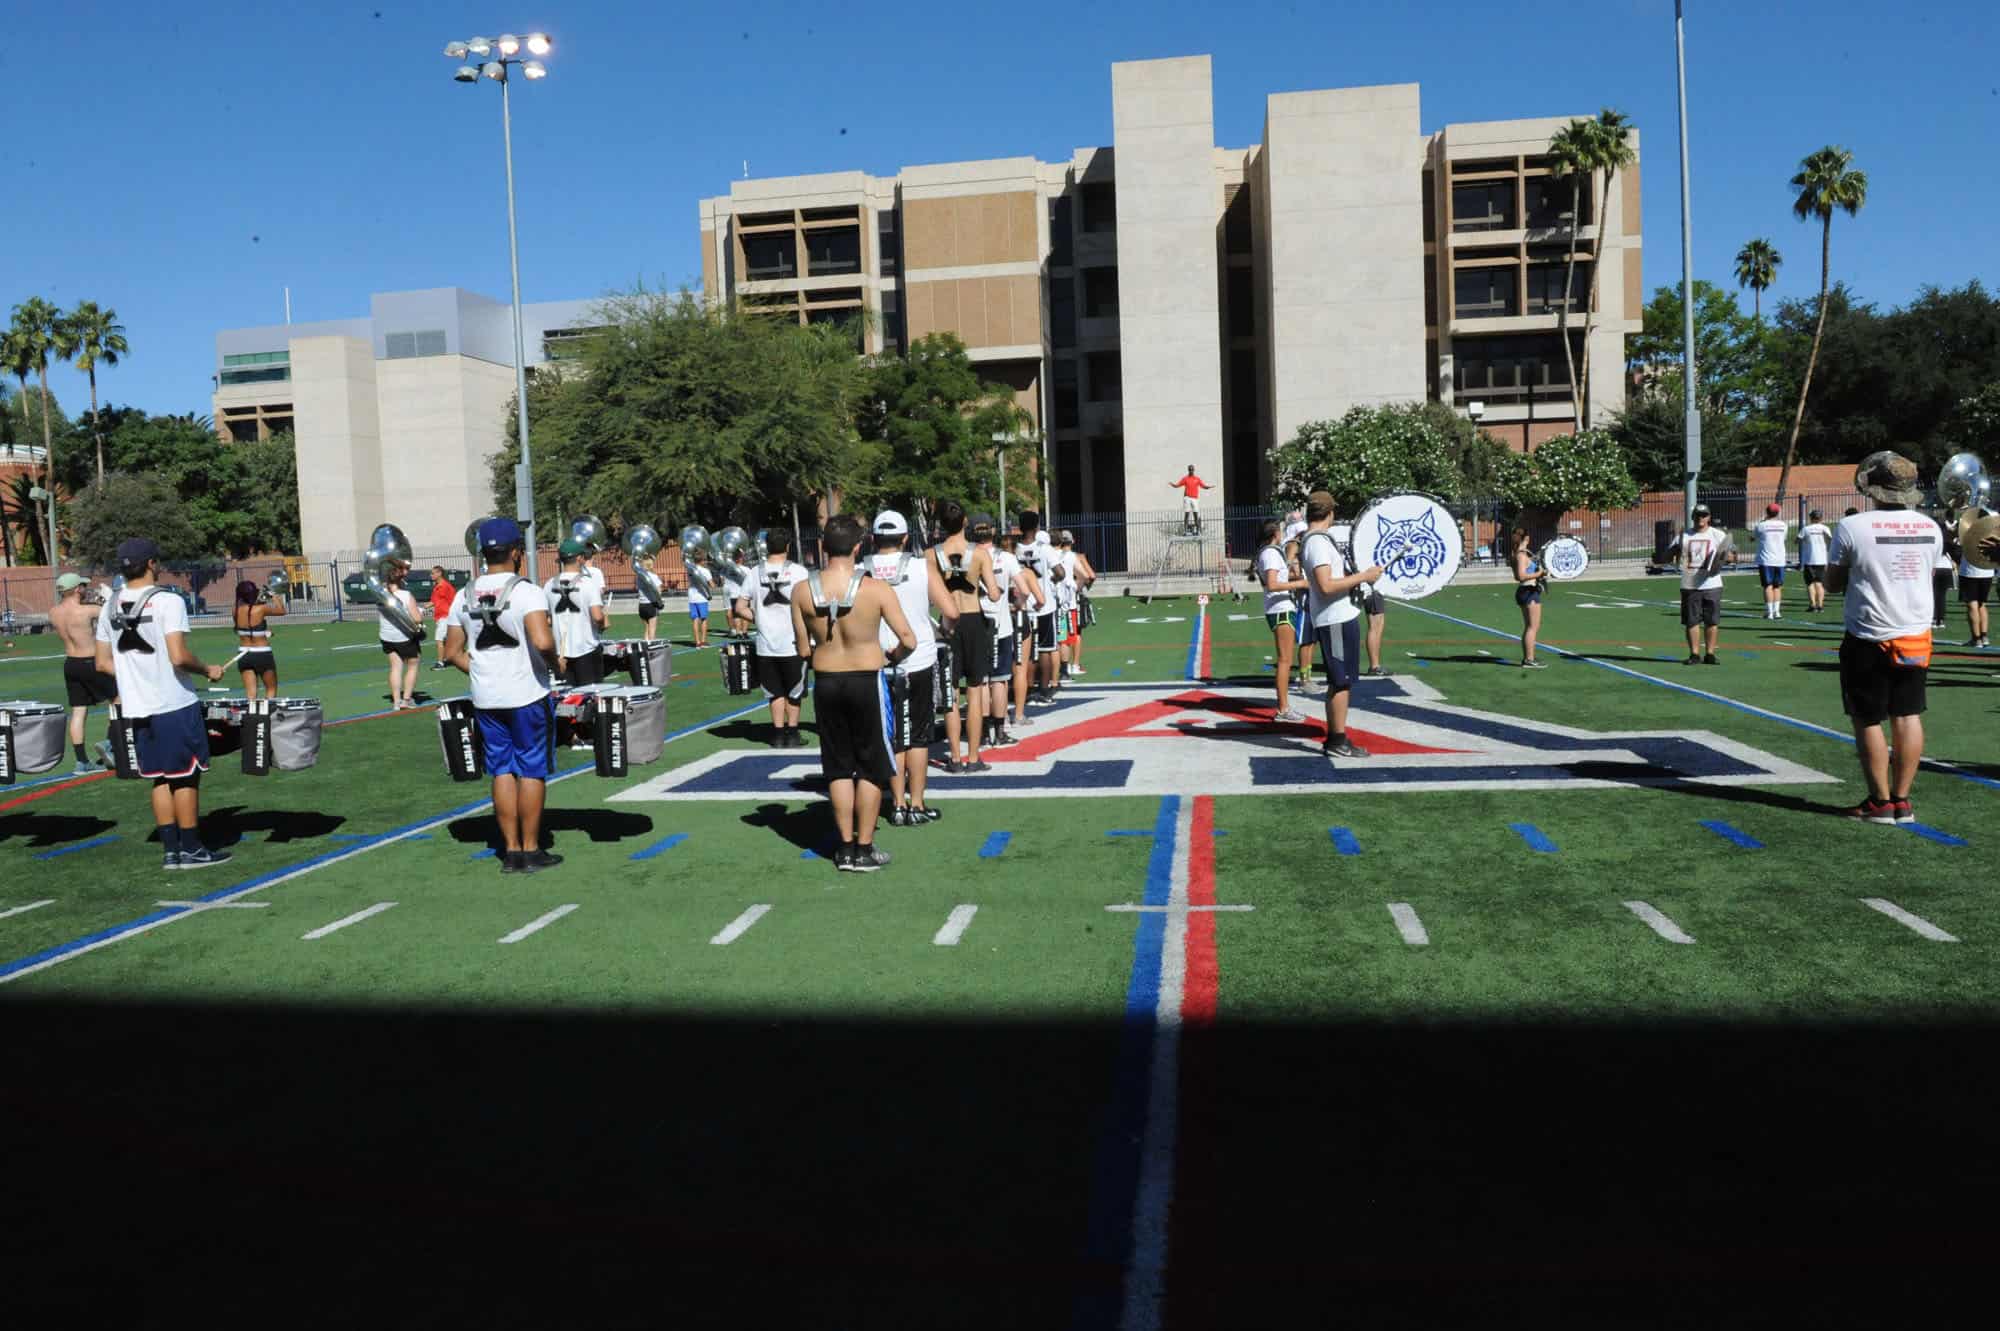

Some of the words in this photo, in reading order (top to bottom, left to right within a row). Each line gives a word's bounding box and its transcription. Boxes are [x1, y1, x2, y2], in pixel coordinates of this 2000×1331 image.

[125, 727, 134, 743] VIC
[256, 722, 265, 738] VIC
[460, 726, 470, 743] VIC
[612, 722, 620, 738] VIC
[256, 740, 264, 768] FIRTH
[463, 744, 476, 773] FIRTH
[612, 740, 621, 768] FIRTH
